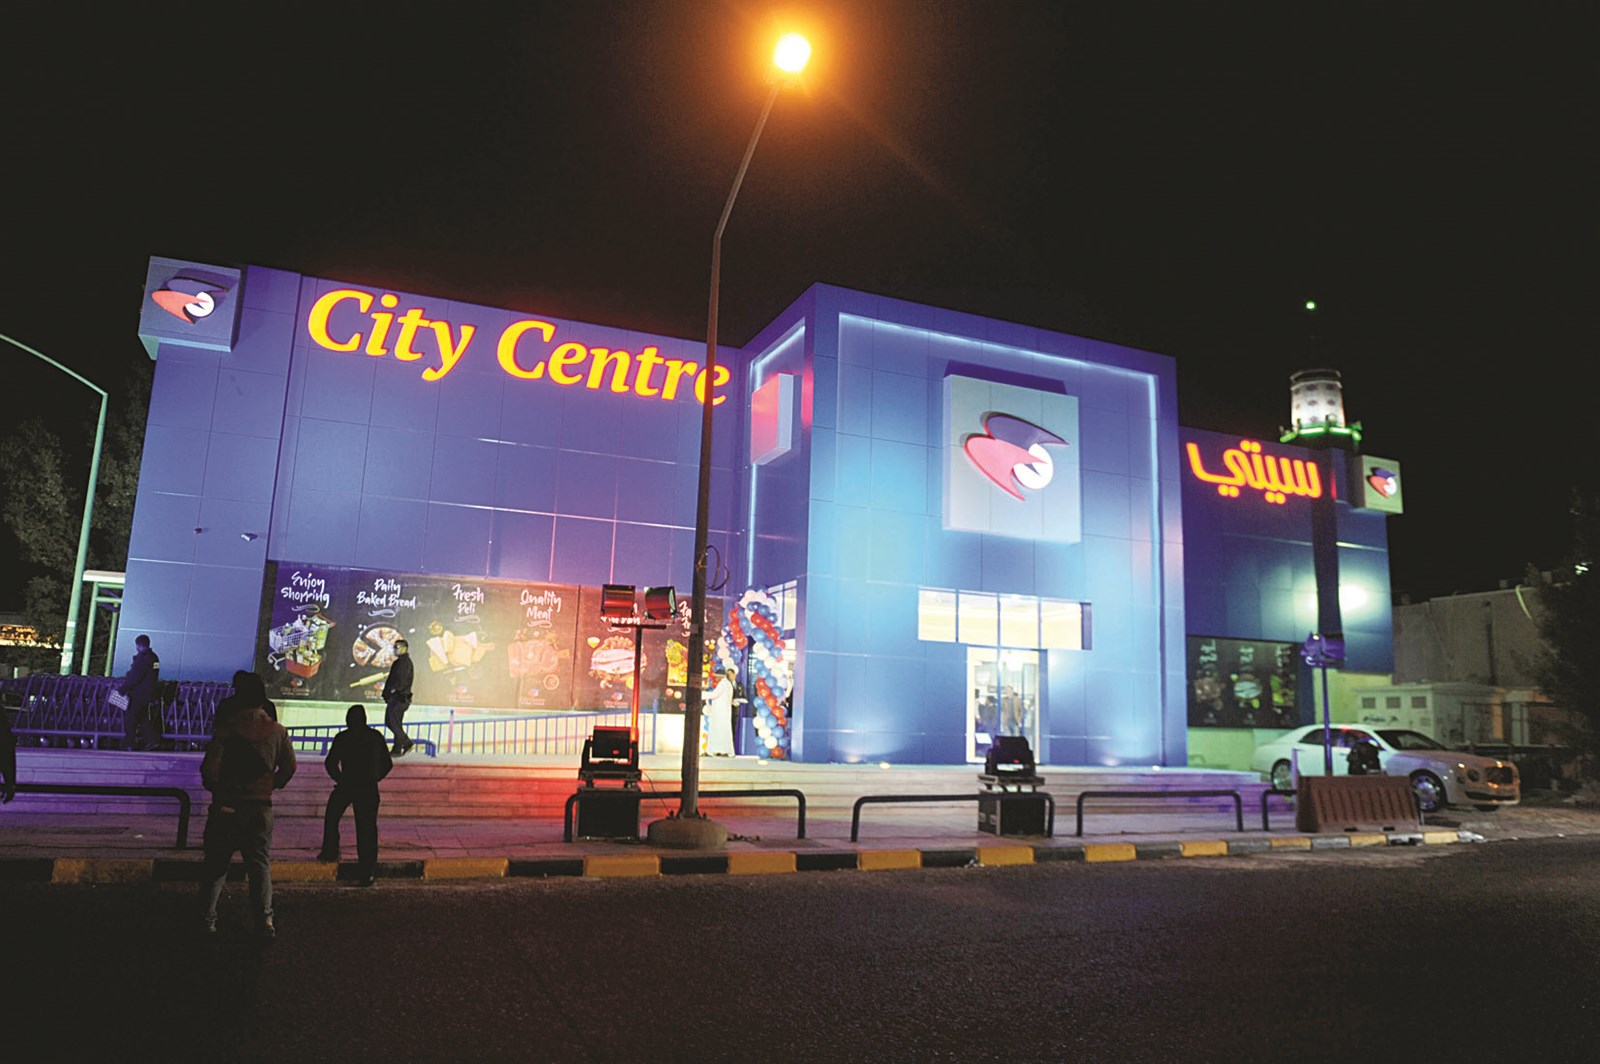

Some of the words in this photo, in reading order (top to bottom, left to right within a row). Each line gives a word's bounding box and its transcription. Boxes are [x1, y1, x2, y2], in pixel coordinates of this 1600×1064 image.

[307, 289, 477, 382] City
[496, 319, 731, 406] Centre
[1185, 440, 1322, 505] سيتي
[291, 571, 325, 594] Enjoy
[374, 578, 401, 598] Daily
[281, 587, 330, 609] Shopping
[356, 591, 387, 608] Baked
[388, 594, 416, 610] Bread
[452, 583, 484, 604] Fresh
[520, 589, 561, 613] Quality
[457, 602, 476, 615] Deli
[526, 605, 553, 621] Meat
